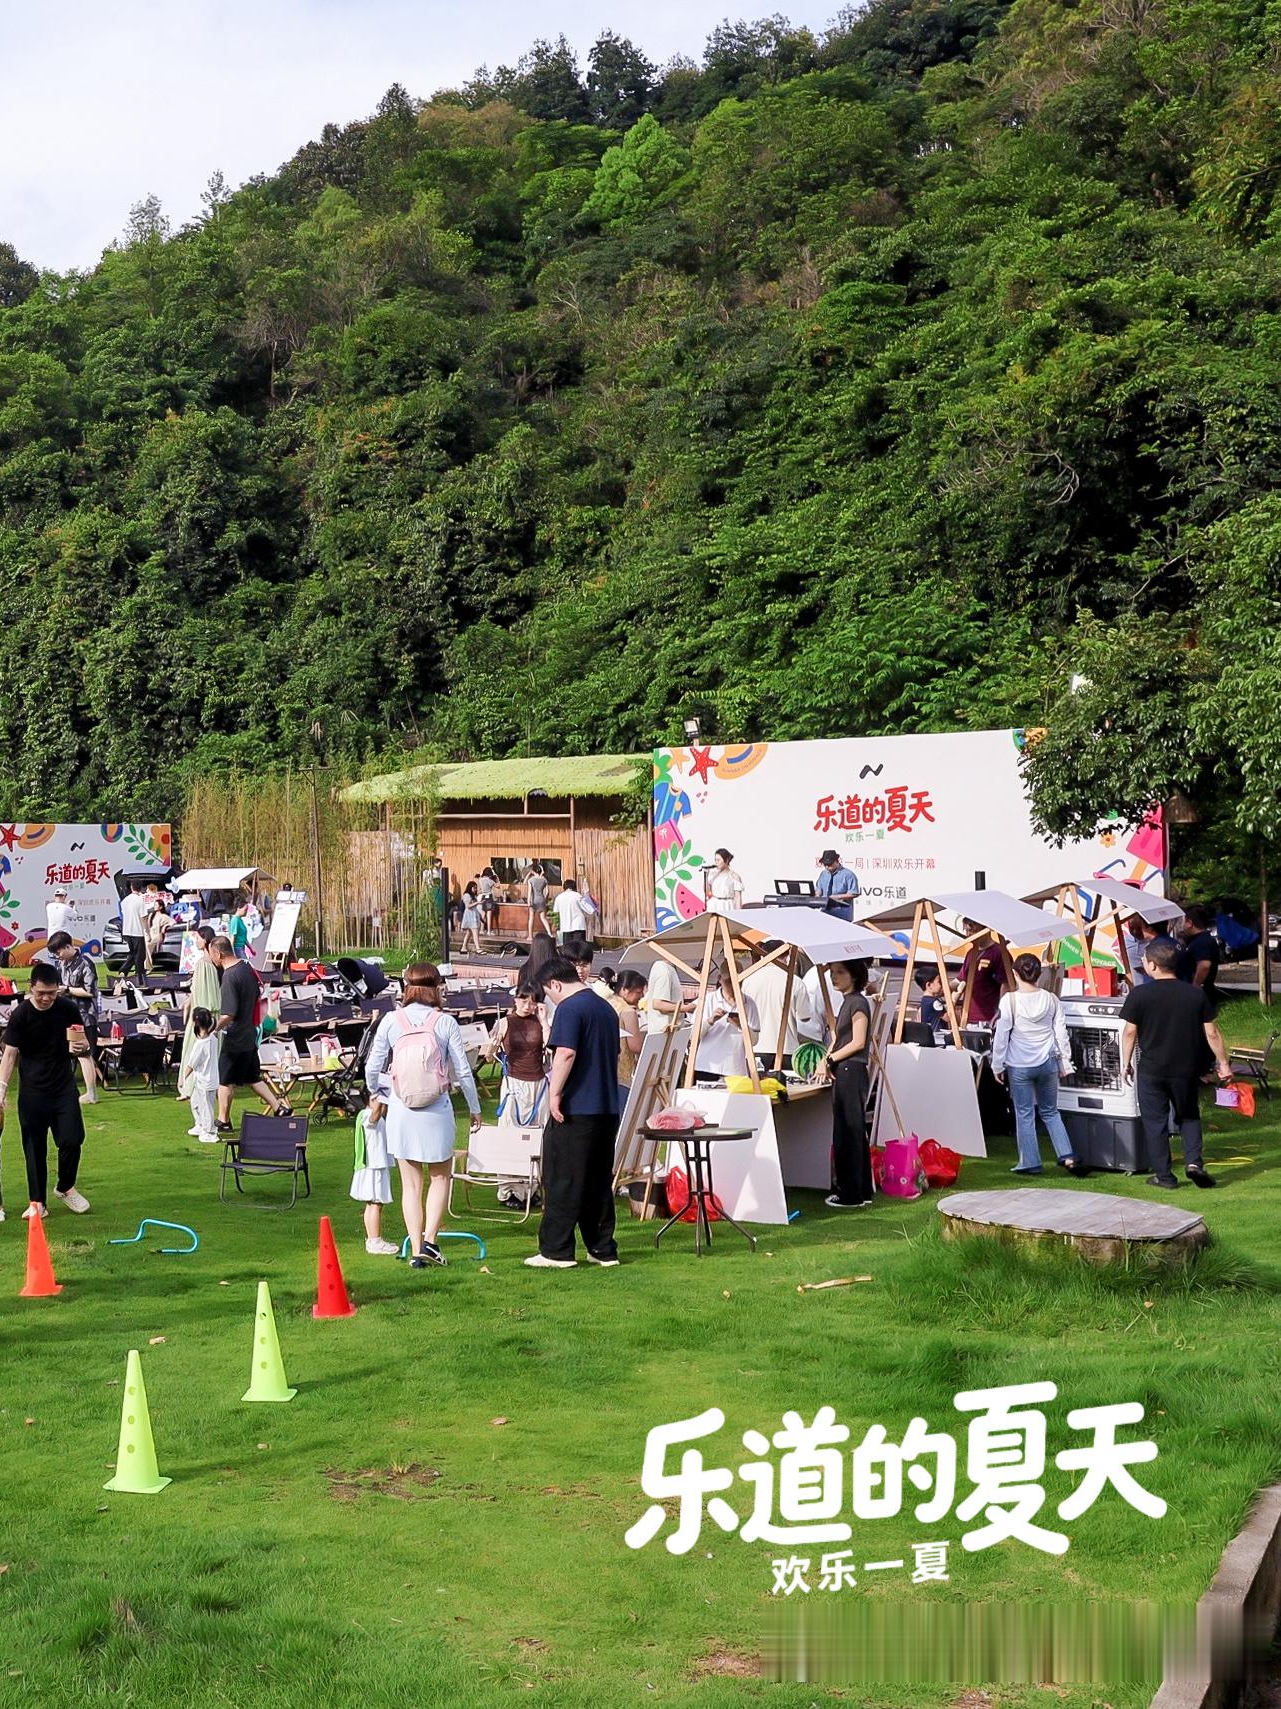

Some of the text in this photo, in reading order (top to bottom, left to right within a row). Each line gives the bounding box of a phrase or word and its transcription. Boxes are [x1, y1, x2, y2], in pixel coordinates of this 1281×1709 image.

[813, 785, 936, 833] 乐道的夏天
[44, 858, 111, 885] 乐道的夏天
